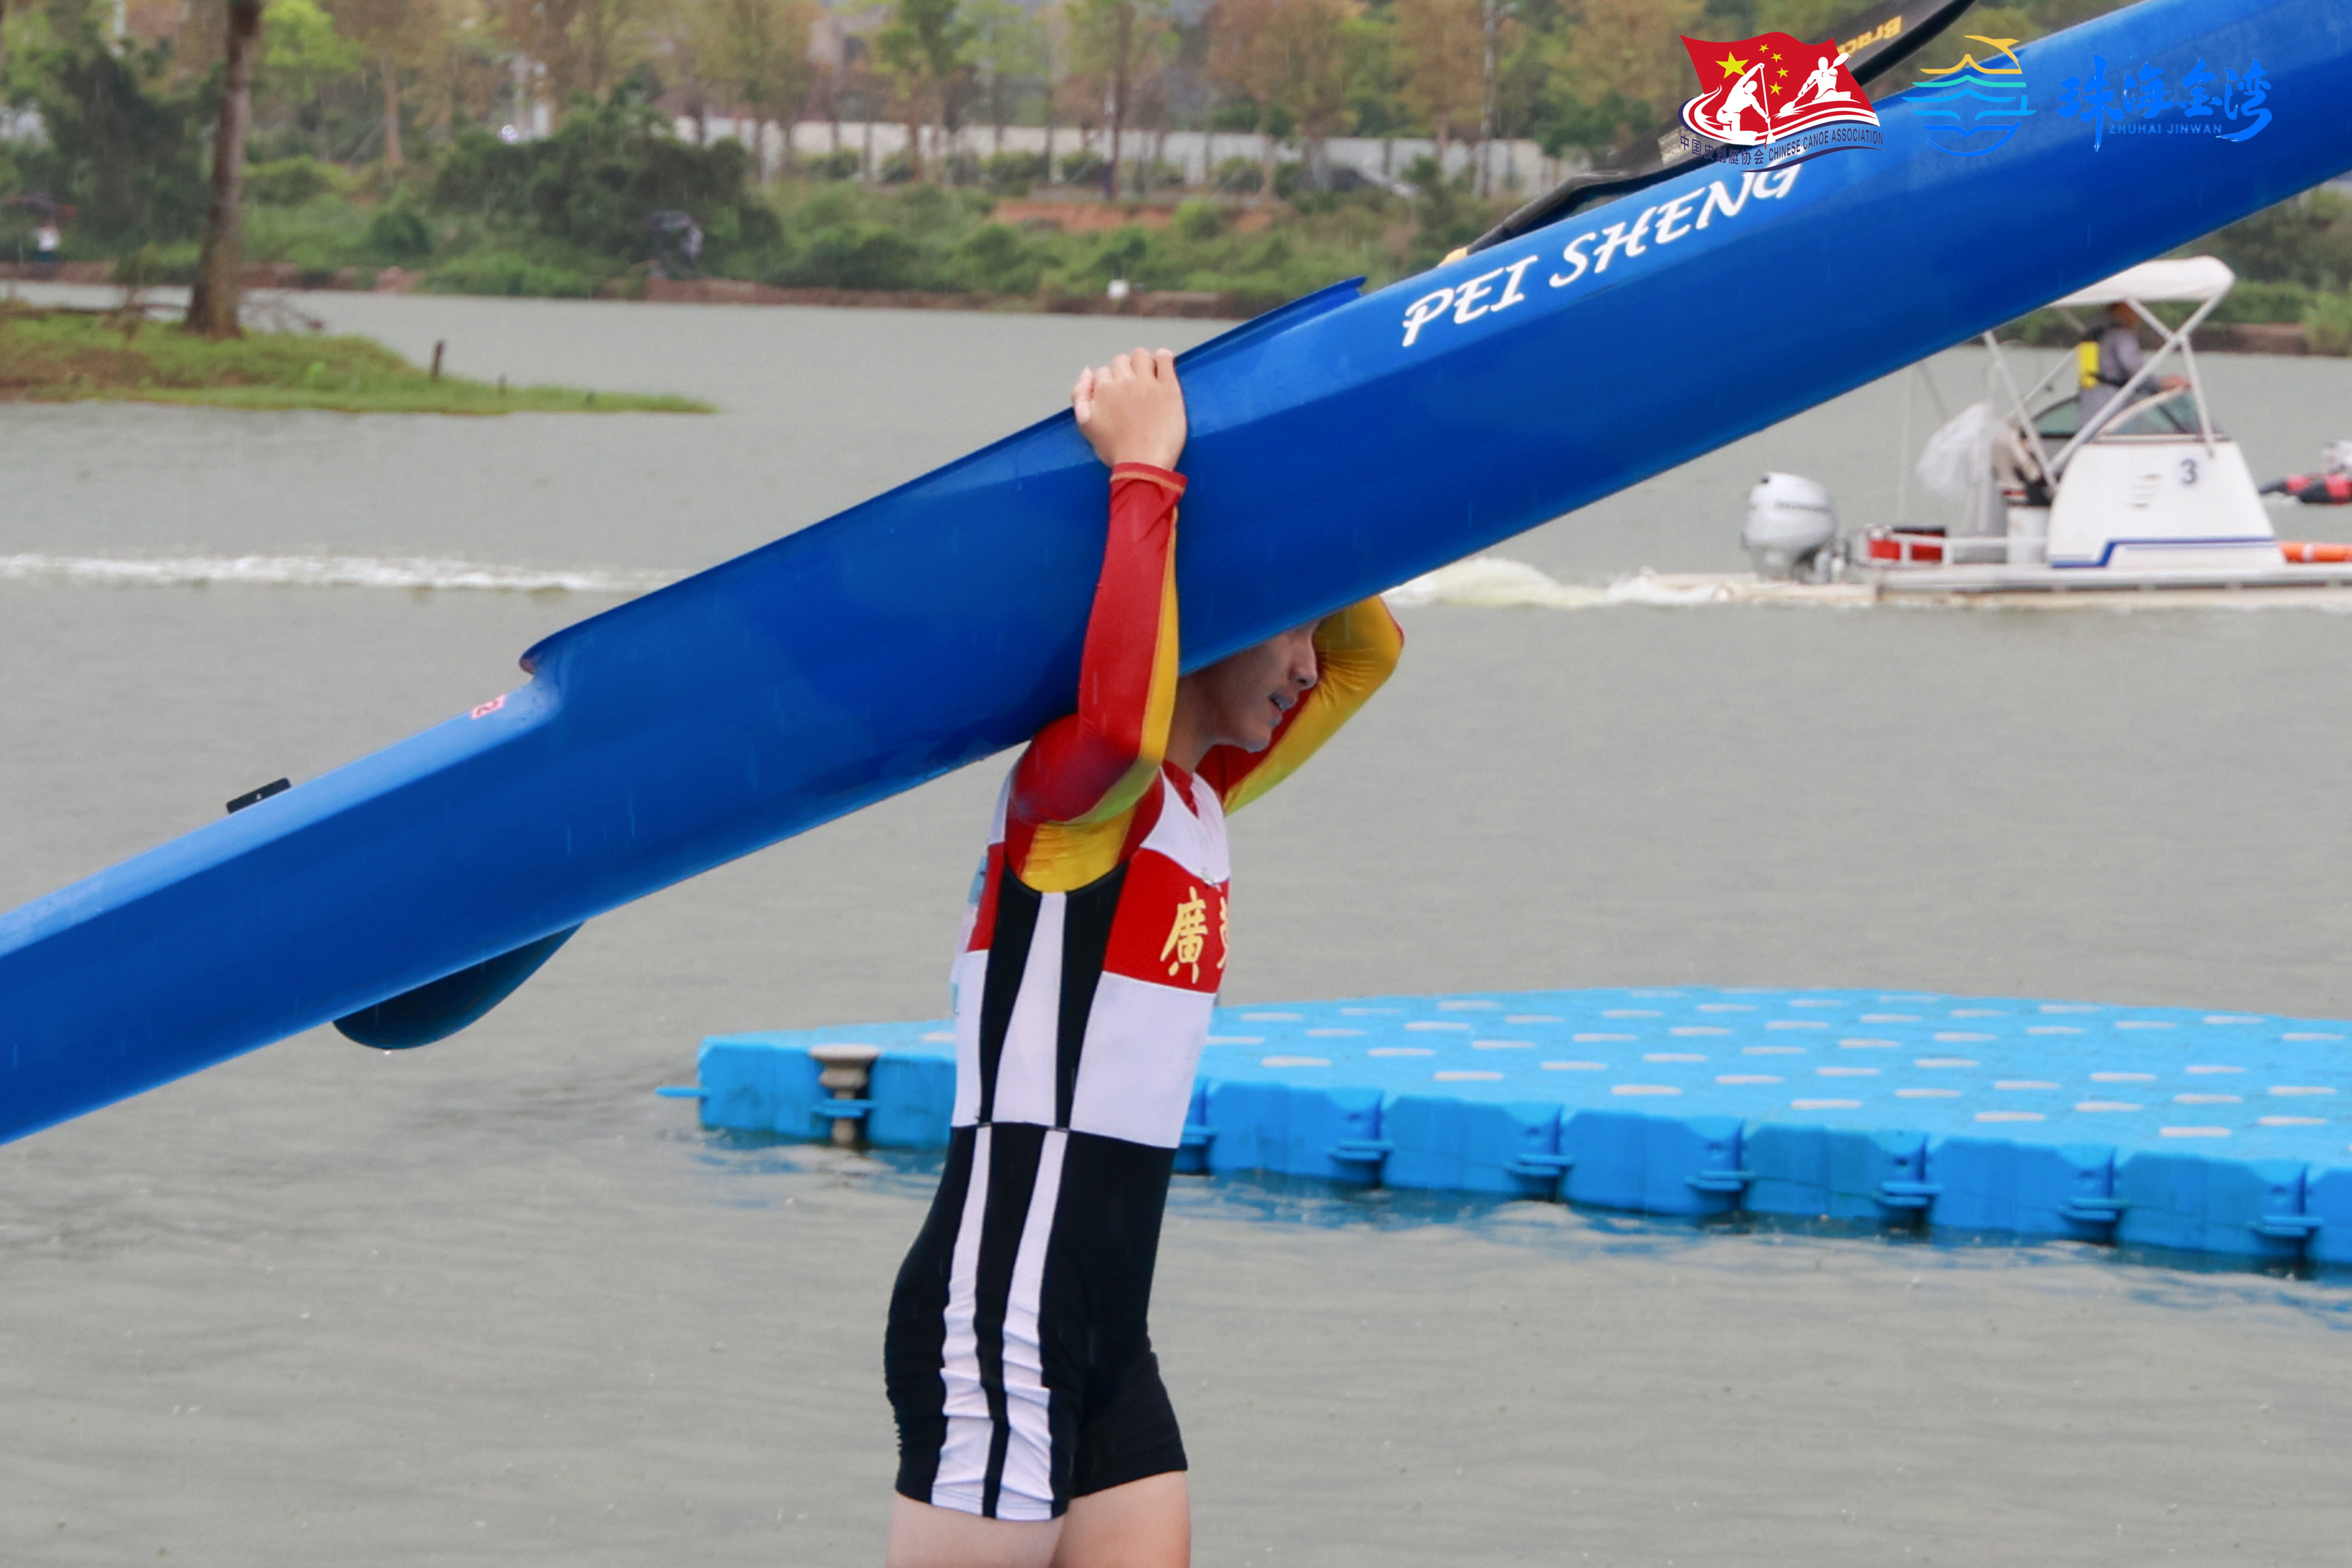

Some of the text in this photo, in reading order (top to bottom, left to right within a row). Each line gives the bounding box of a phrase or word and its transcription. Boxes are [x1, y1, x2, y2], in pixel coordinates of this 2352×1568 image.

[1401, 146, 1808, 347] PEI SHENG
[2180, 457, 2198, 485] 3
